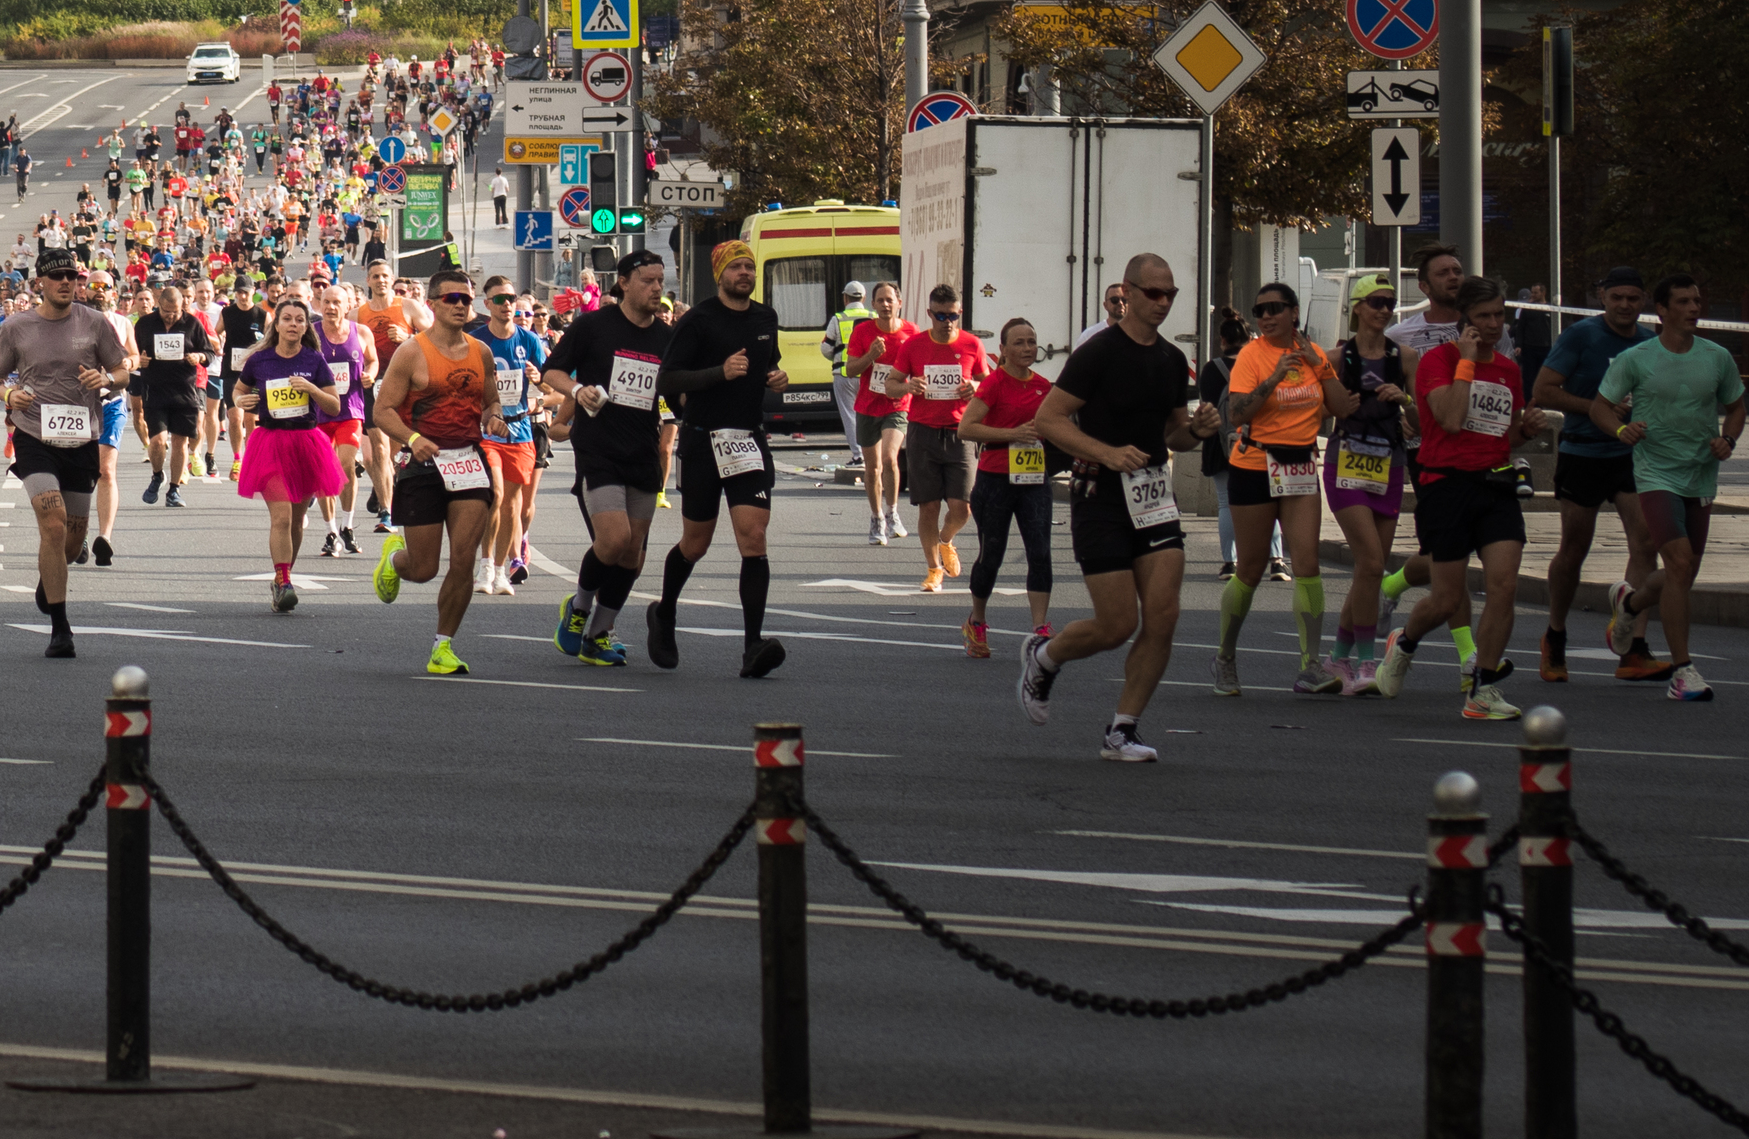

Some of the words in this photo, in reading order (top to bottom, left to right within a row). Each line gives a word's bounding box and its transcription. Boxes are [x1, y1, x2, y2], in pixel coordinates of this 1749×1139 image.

[529, 87, 576, 95] НЕГЛИННАЯ
[661, 187, 714, 201] СТОП
[159, 340, 180, 349] 1543
[617, 371, 653, 390] 4910
[926, 374, 960, 385] 14303
[818, 391, 828, 399] 799
[1471, 393, 1511, 416] 14842
[48, 417, 84, 431] 6728
[714, 441, 758, 457] 13088
[1016, 451, 1042, 465] 6776
[439, 459, 482, 475] 20503
[1270, 461, 1316, 477] 21830
[1345, 455, 1383, 474] 2406
[722, 467, 730, 475] G
[451, 481, 456, 489] F
[1015, 475, 1020, 483] F
[1340, 479, 1348, 488] G
[1132, 480, 1166, 504] 3767
[1276, 485, 1284, 494] G
[1136, 517, 1144, 527] H
